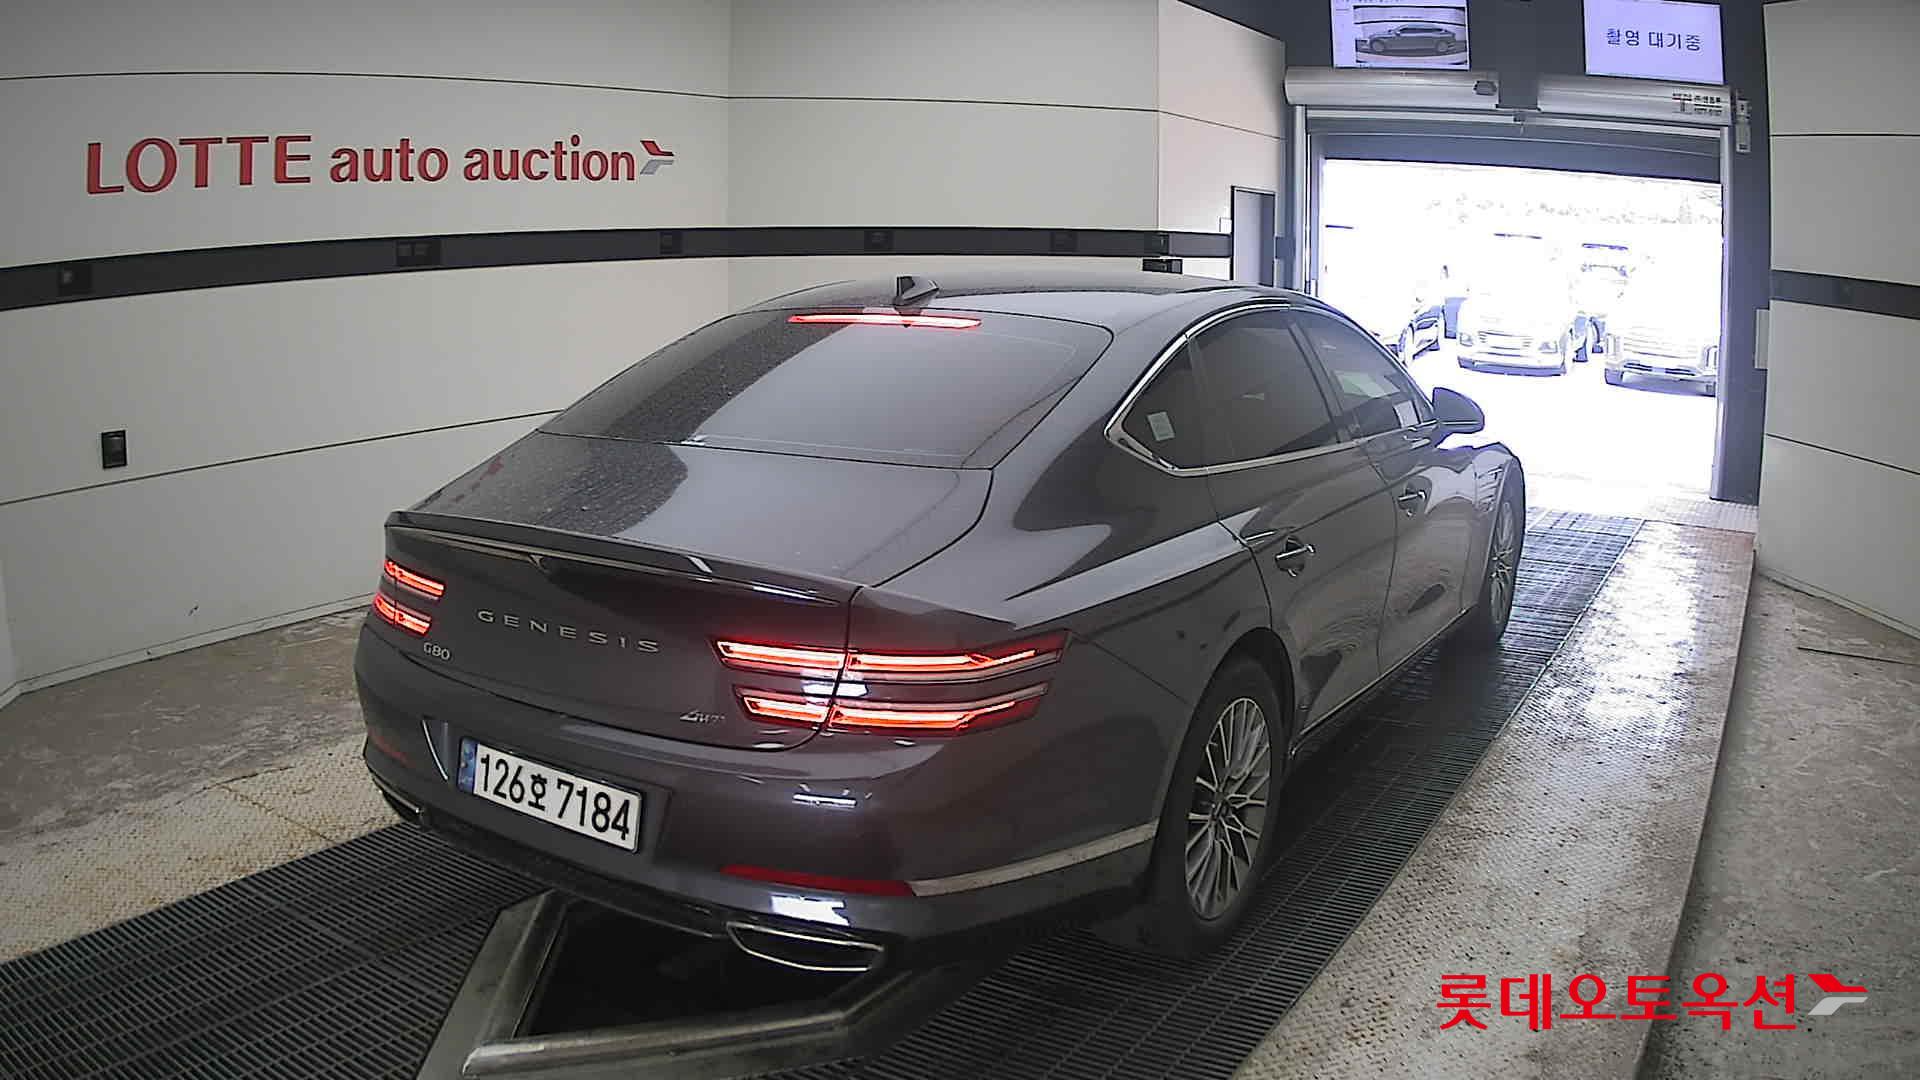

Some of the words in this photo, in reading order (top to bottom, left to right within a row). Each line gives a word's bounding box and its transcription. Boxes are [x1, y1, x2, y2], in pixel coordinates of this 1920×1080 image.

[1607, 28, 1640, 46] 촬영
[1648, 31, 1701, 51] 대기중
[86, 135, 312, 194] LOTTE
[329, 138, 448, 182] auto
[463, 134, 635, 181] auction
[423, 641, 451, 660] G80
[477, 610, 660, 653] GENESIS
[480, 753, 548, 811] 126호
[556, 778, 632, 841] 7184
